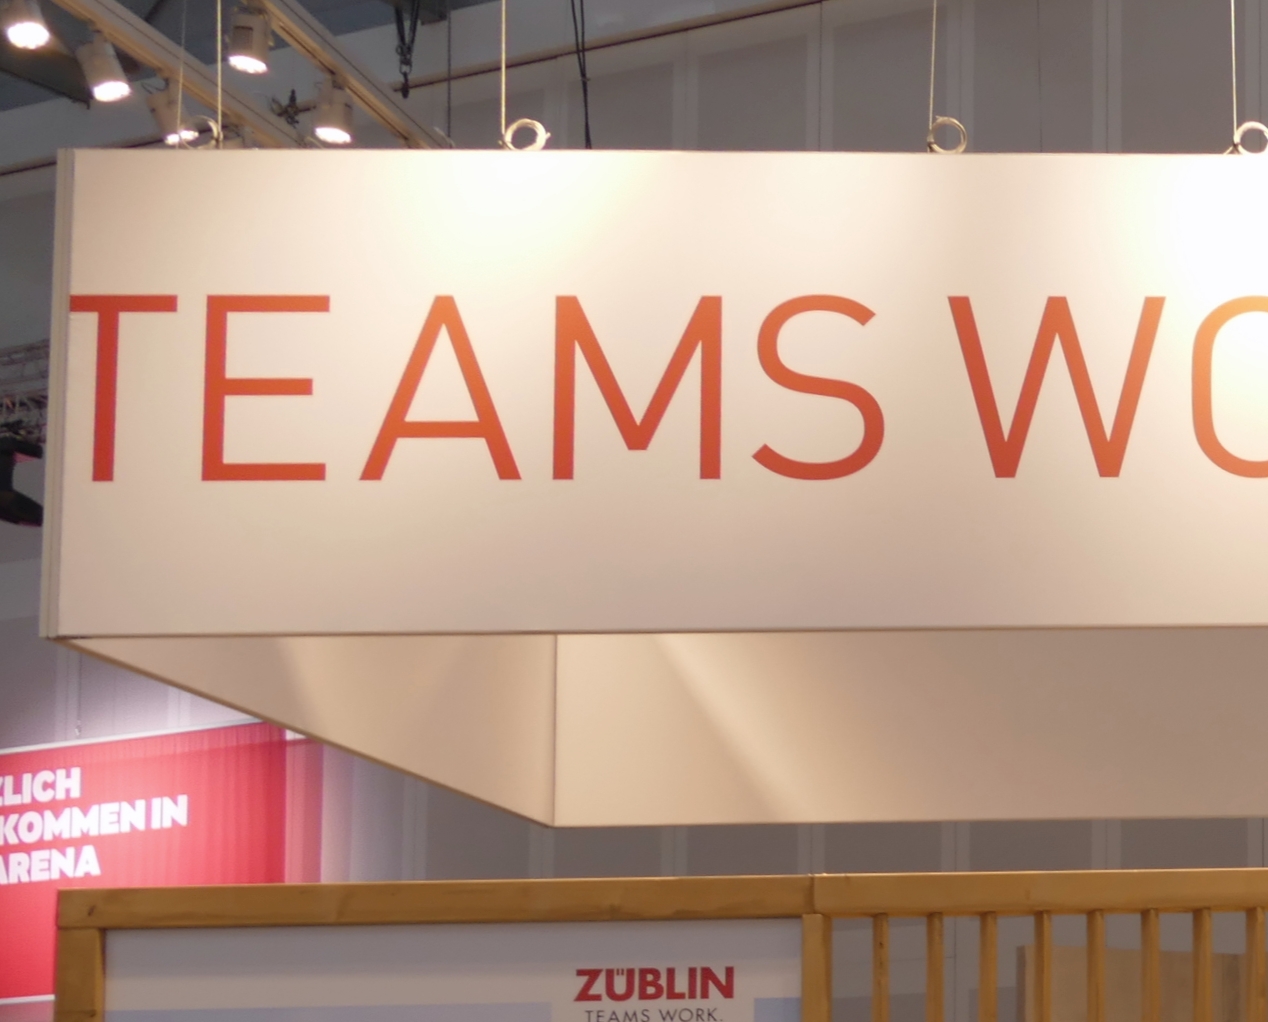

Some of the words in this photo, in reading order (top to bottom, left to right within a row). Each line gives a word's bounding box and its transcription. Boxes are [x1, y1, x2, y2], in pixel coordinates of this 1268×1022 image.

[69, 294, 885, 482] TEAMS
[0, 767, 81, 806] LICH
[151, 795, 188, 829] IN
[573, 966, 734, 1002] ZÜBLIN
[659, 1007, 723, 1022] WORK.
